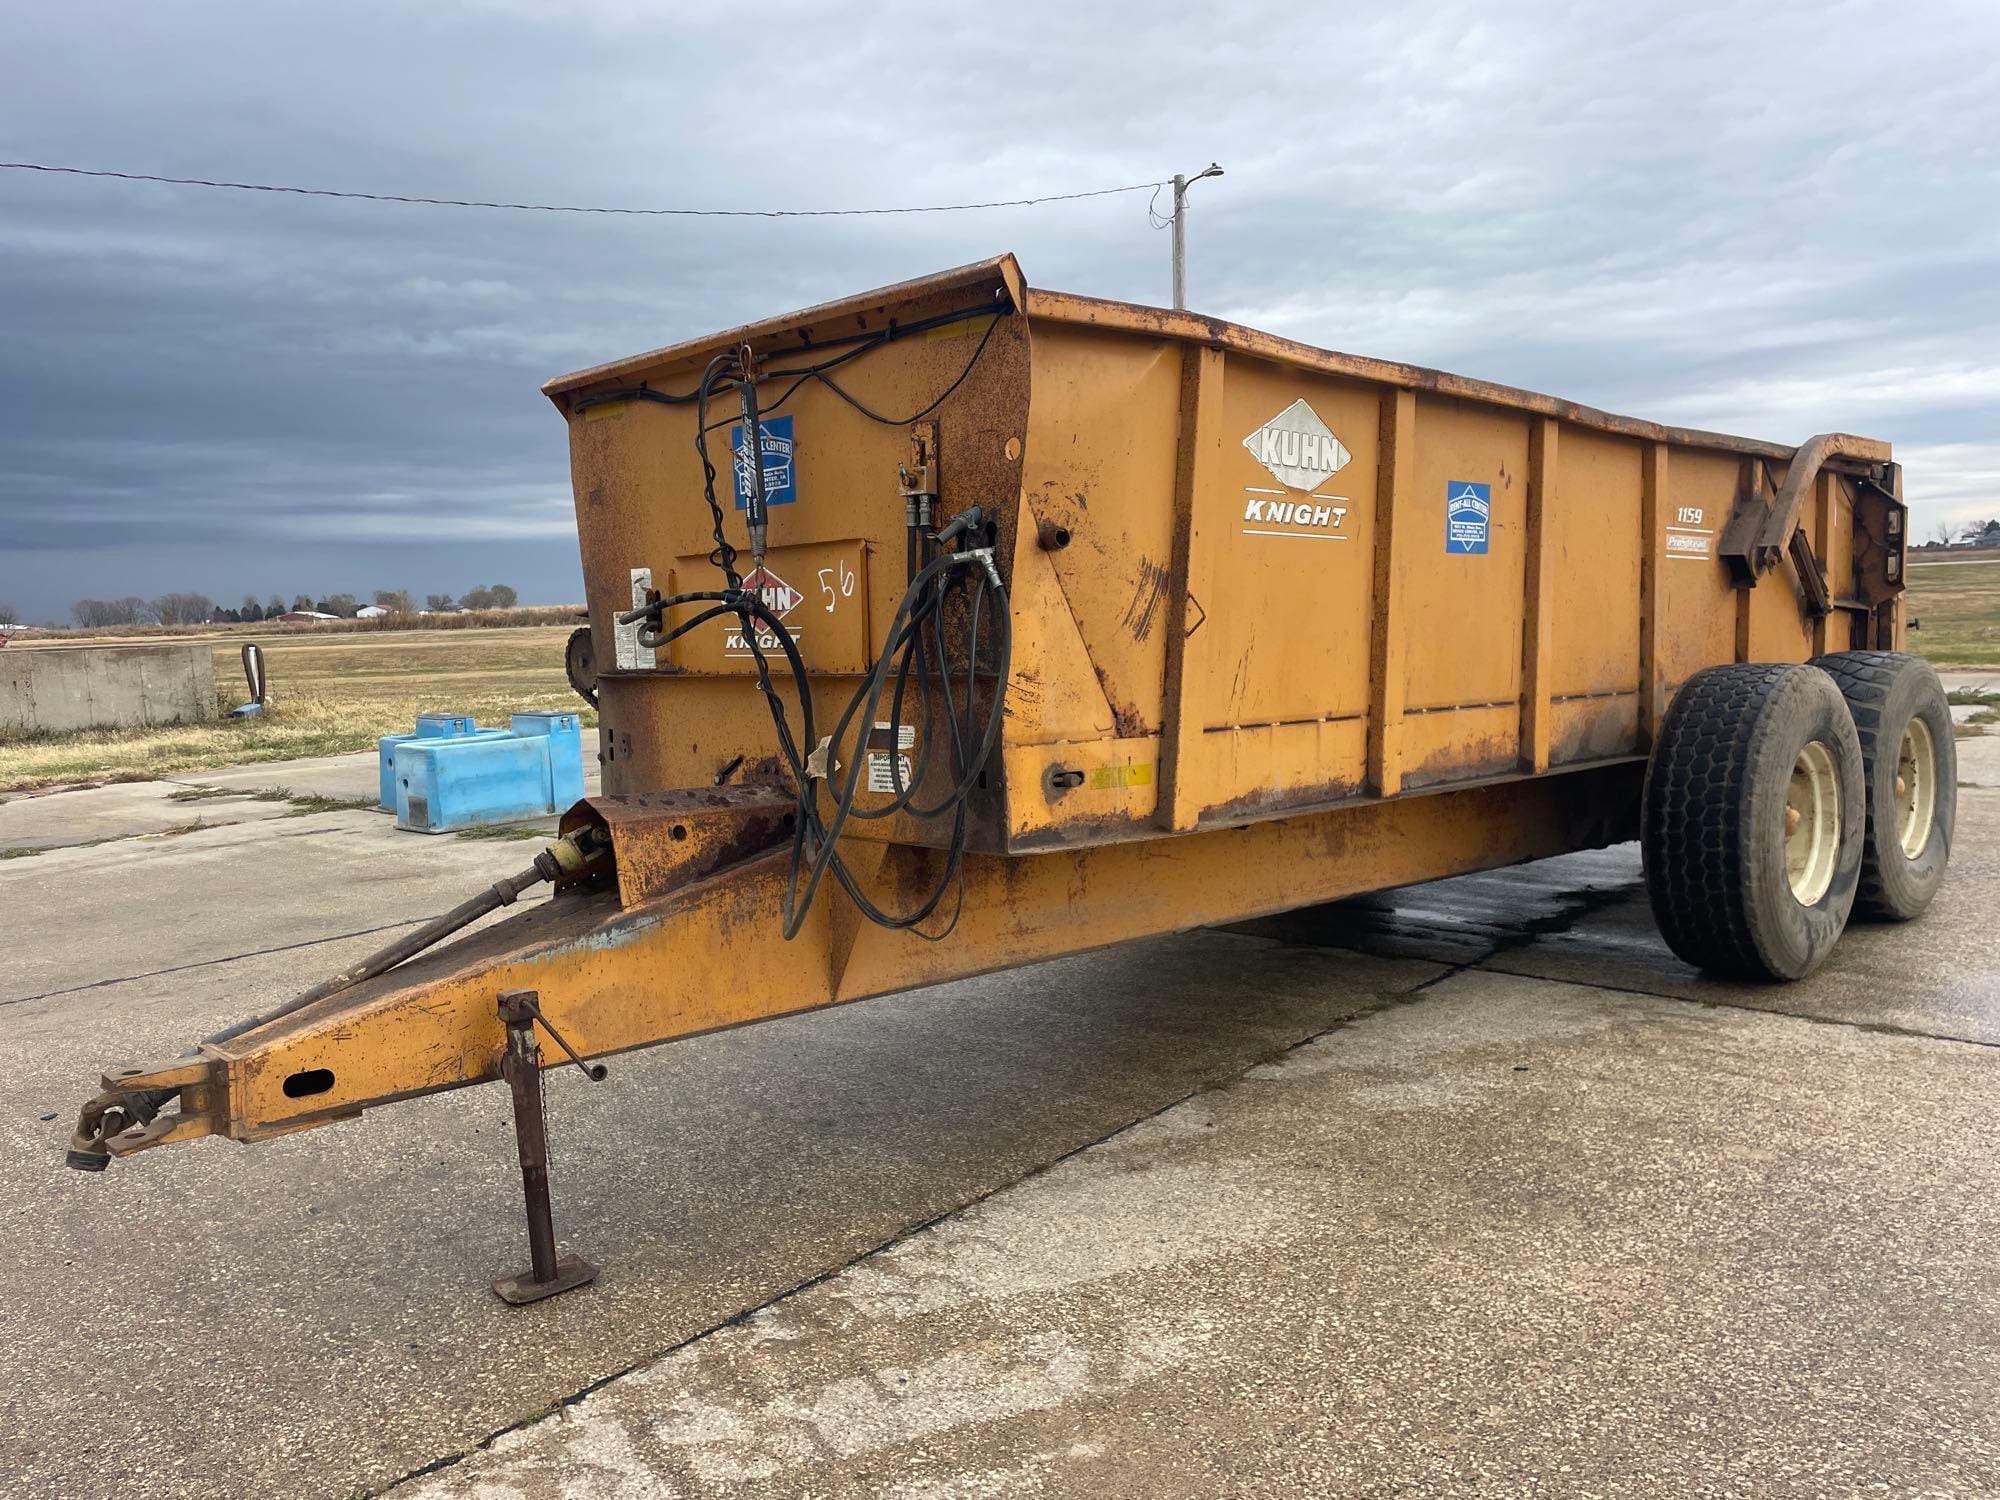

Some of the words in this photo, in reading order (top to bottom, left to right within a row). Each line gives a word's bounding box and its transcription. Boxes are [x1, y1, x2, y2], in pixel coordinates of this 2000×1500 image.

[766, 440, 790, 454] CENTER
[1261, 427, 1339, 472] KUHN
[1244, 499, 1347, 527] KNIGHT
[1678, 507, 1703, 524] 1159
[818, 559, 855, 612] 56
